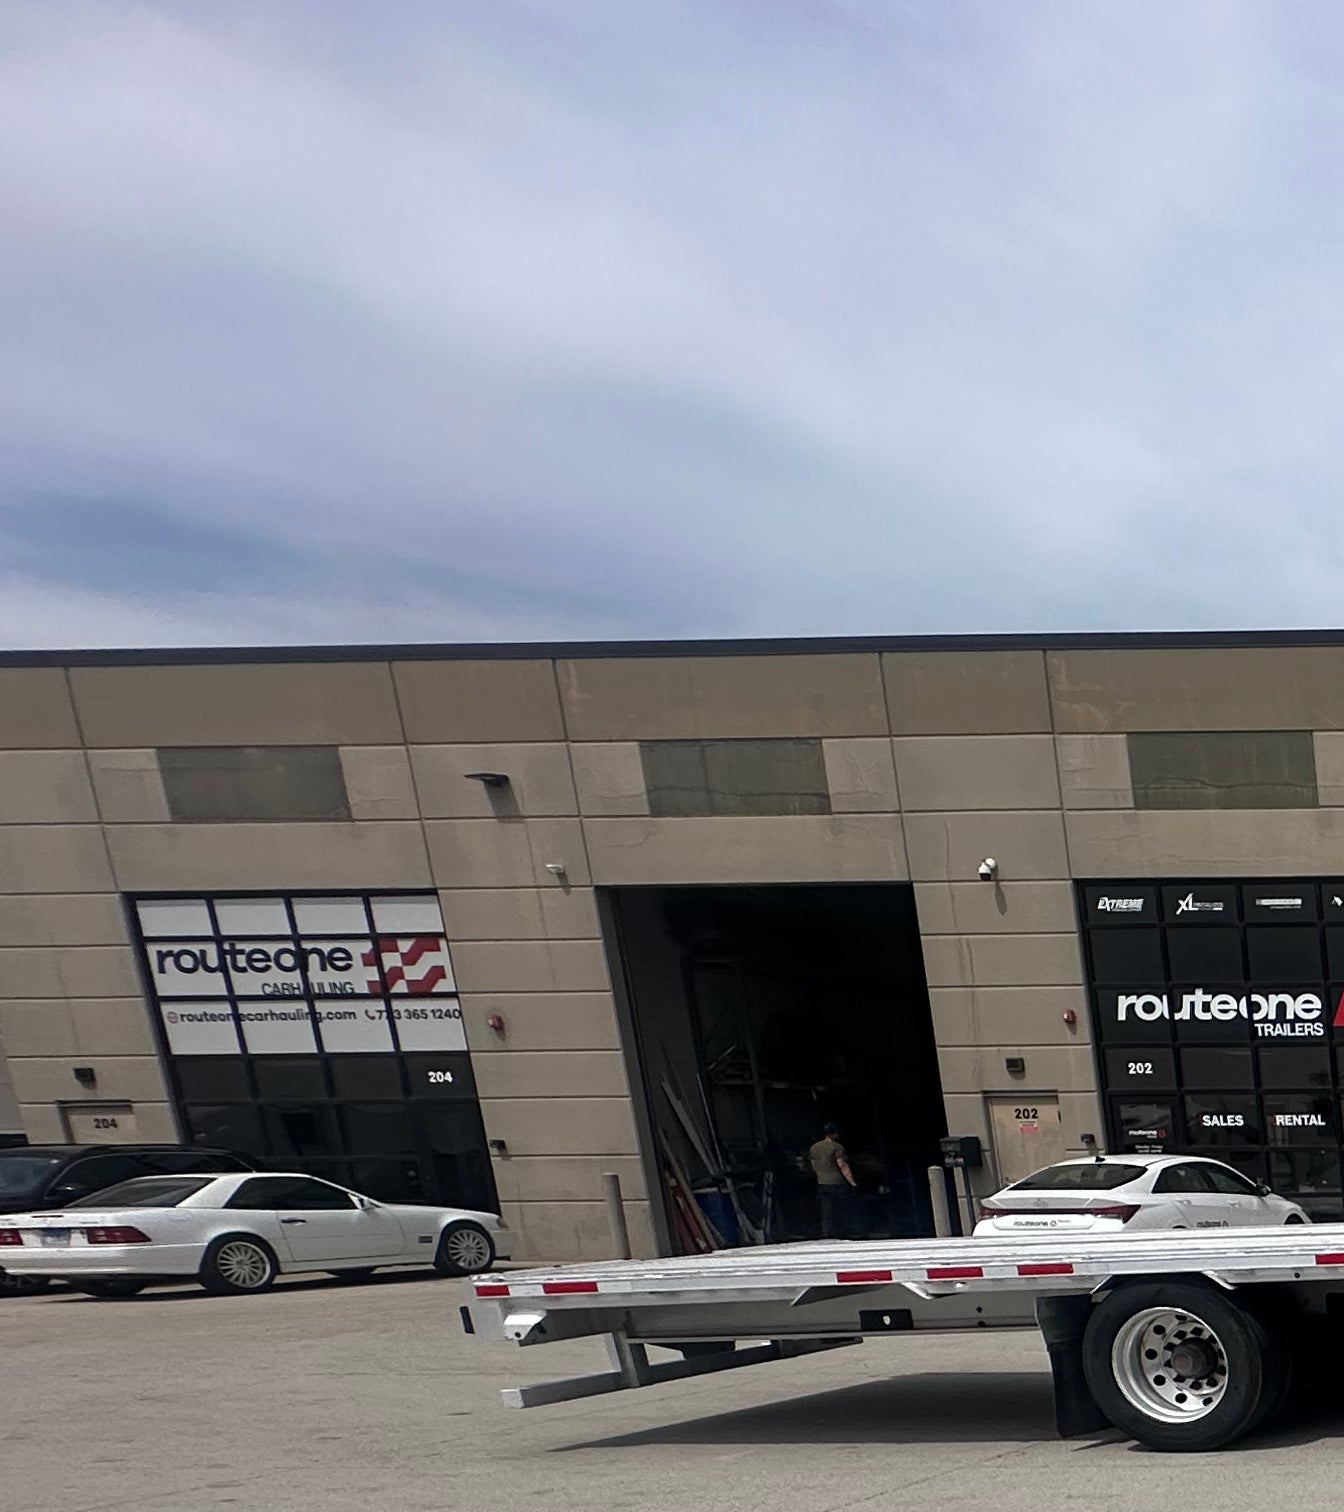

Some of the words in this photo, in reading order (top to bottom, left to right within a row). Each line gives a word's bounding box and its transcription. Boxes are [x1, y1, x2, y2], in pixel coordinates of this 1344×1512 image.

[156, 942, 354, 975] routeone
[261, 981, 355, 995] CARHULING
[1117, 988, 1322, 1021] routeone
[403, 1008, 428, 1020] 365
[430, 1007, 462, 1021] 1240
[1254, 1022, 1324, 1037] TRAILERS
[1128, 1062, 1153, 1075] 202
[428, 1071, 453, 1084] 204
[1014, 1108, 1039, 1120] 202
[1202, 1114, 1244, 1127] SALES
[1276, 1113, 1326, 1127] RENTAL
[93, 1117, 118, 1130] 204
